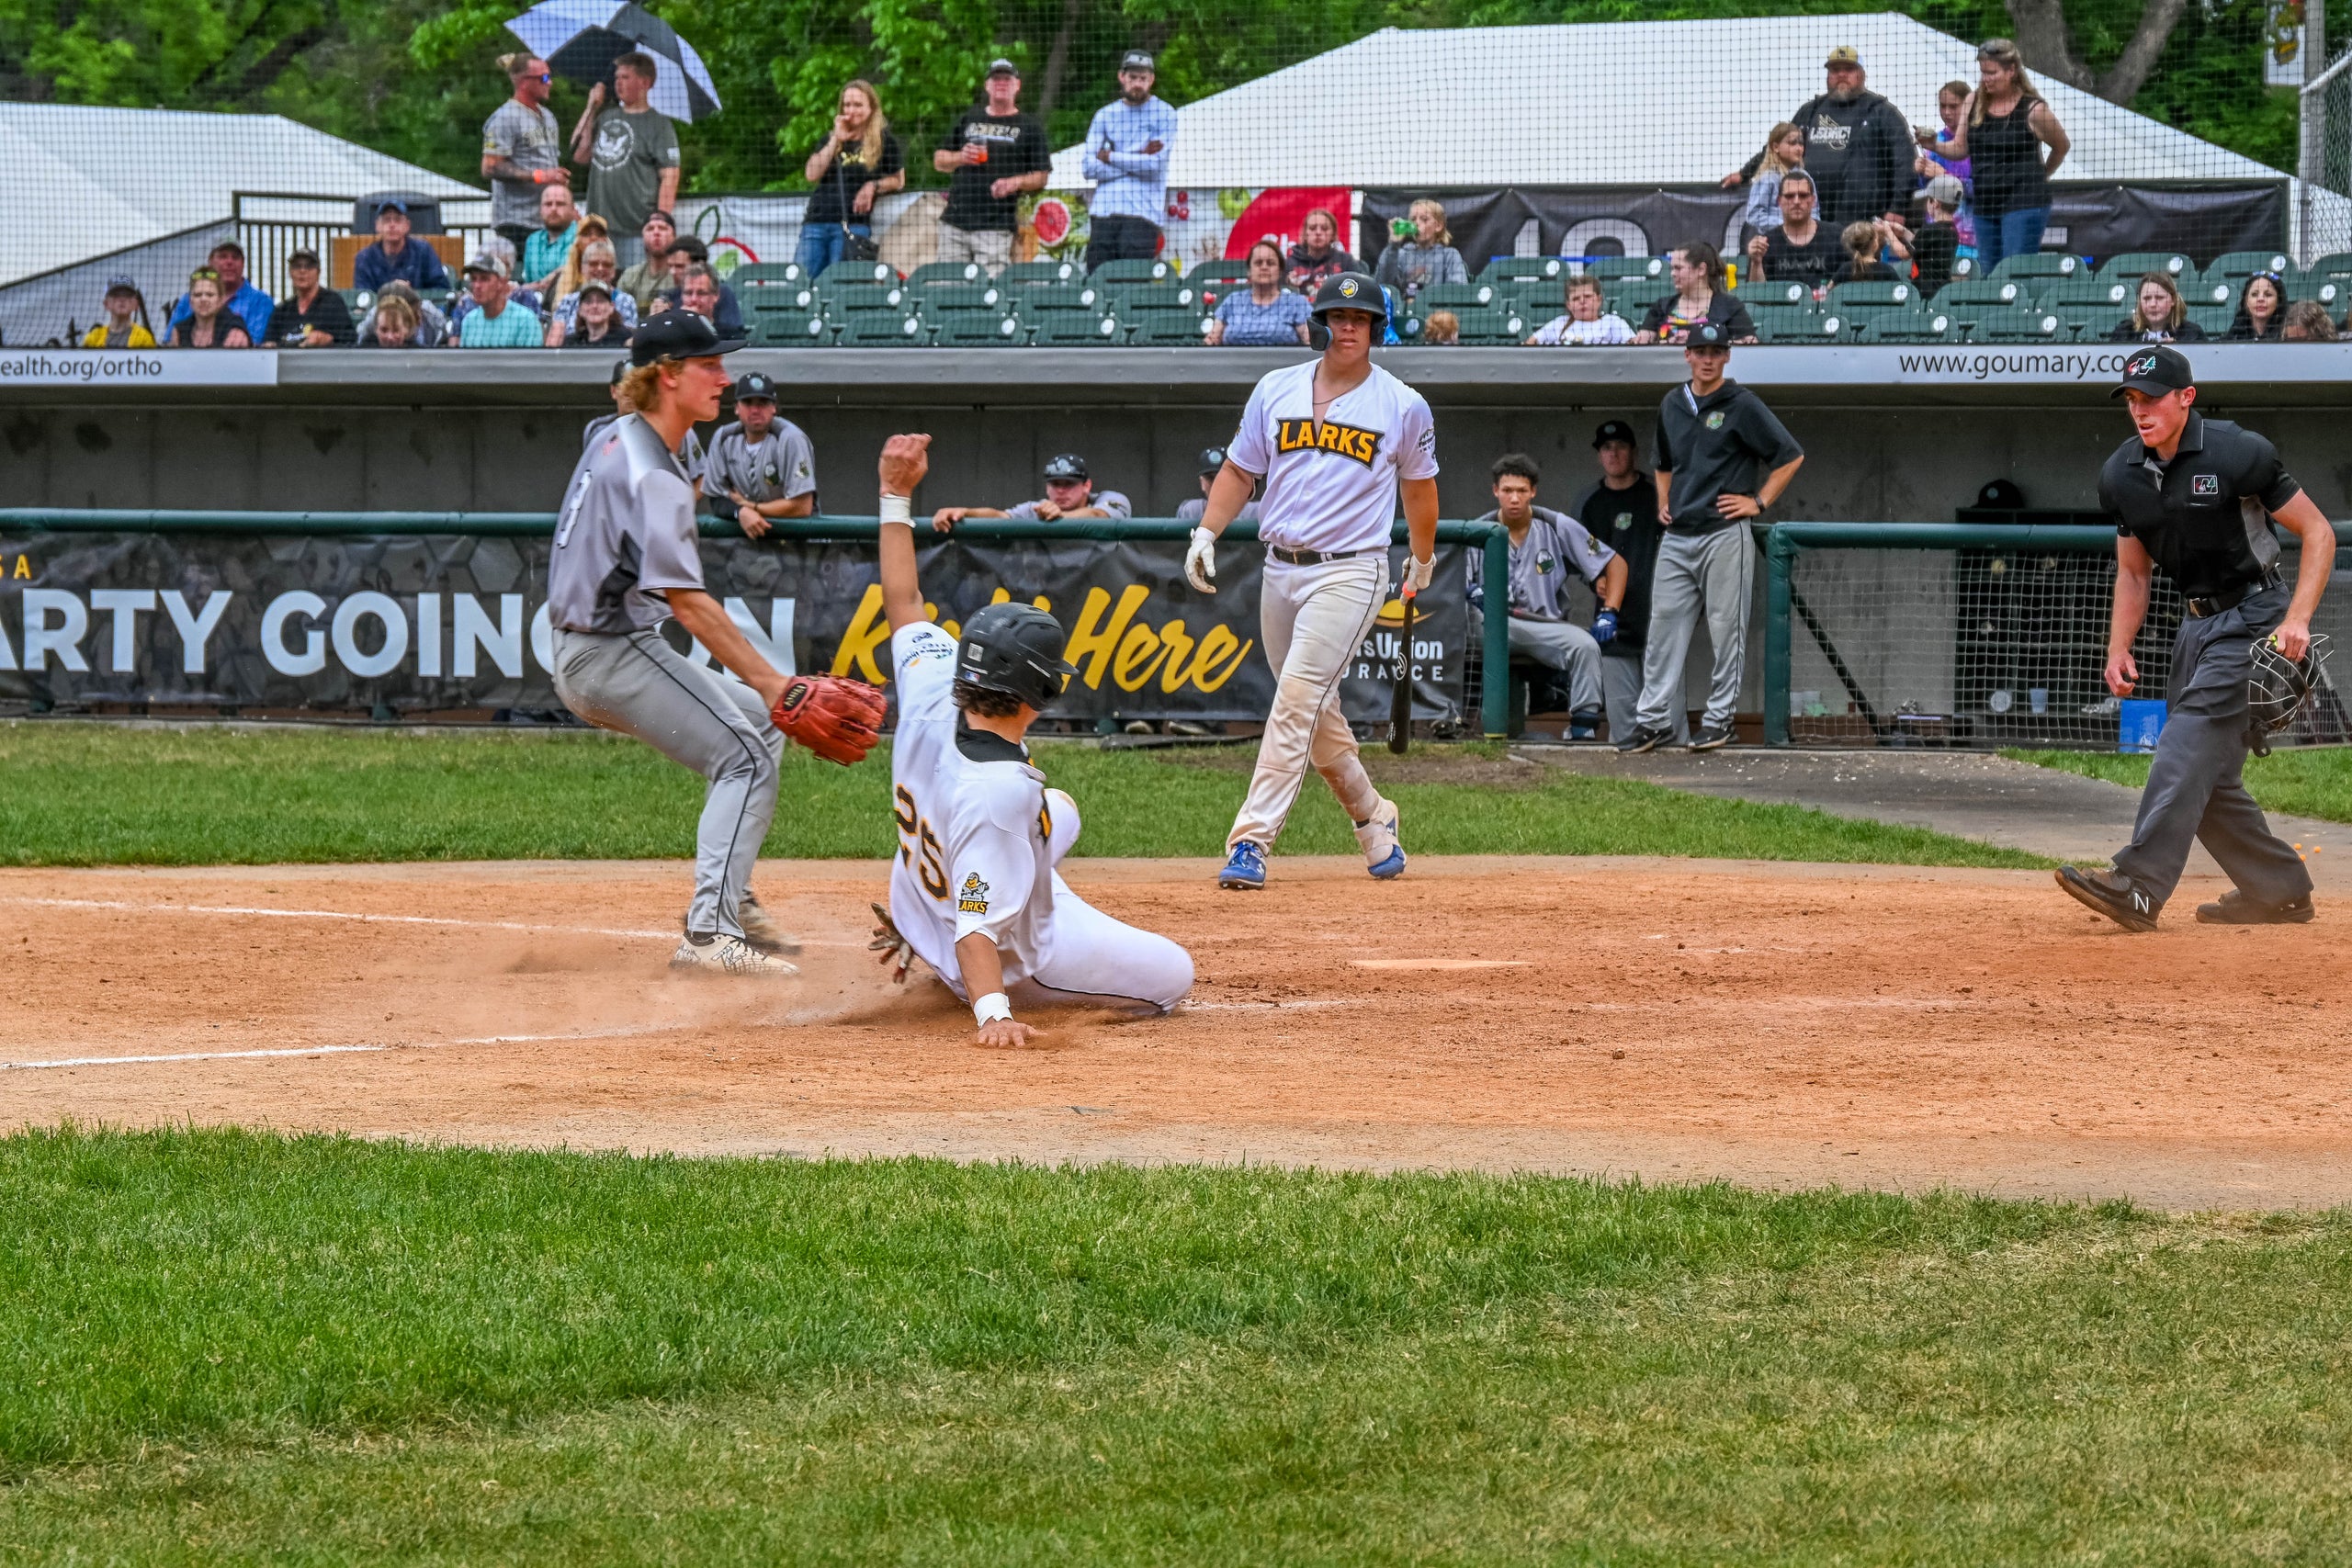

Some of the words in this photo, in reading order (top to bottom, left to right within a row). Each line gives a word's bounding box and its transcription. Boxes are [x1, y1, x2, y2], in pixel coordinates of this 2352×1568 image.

[1281, 422, 1375, 463] LARKS
[0, 588, 233, 673] RTY
[1059, 584, 1252, 694] Here
